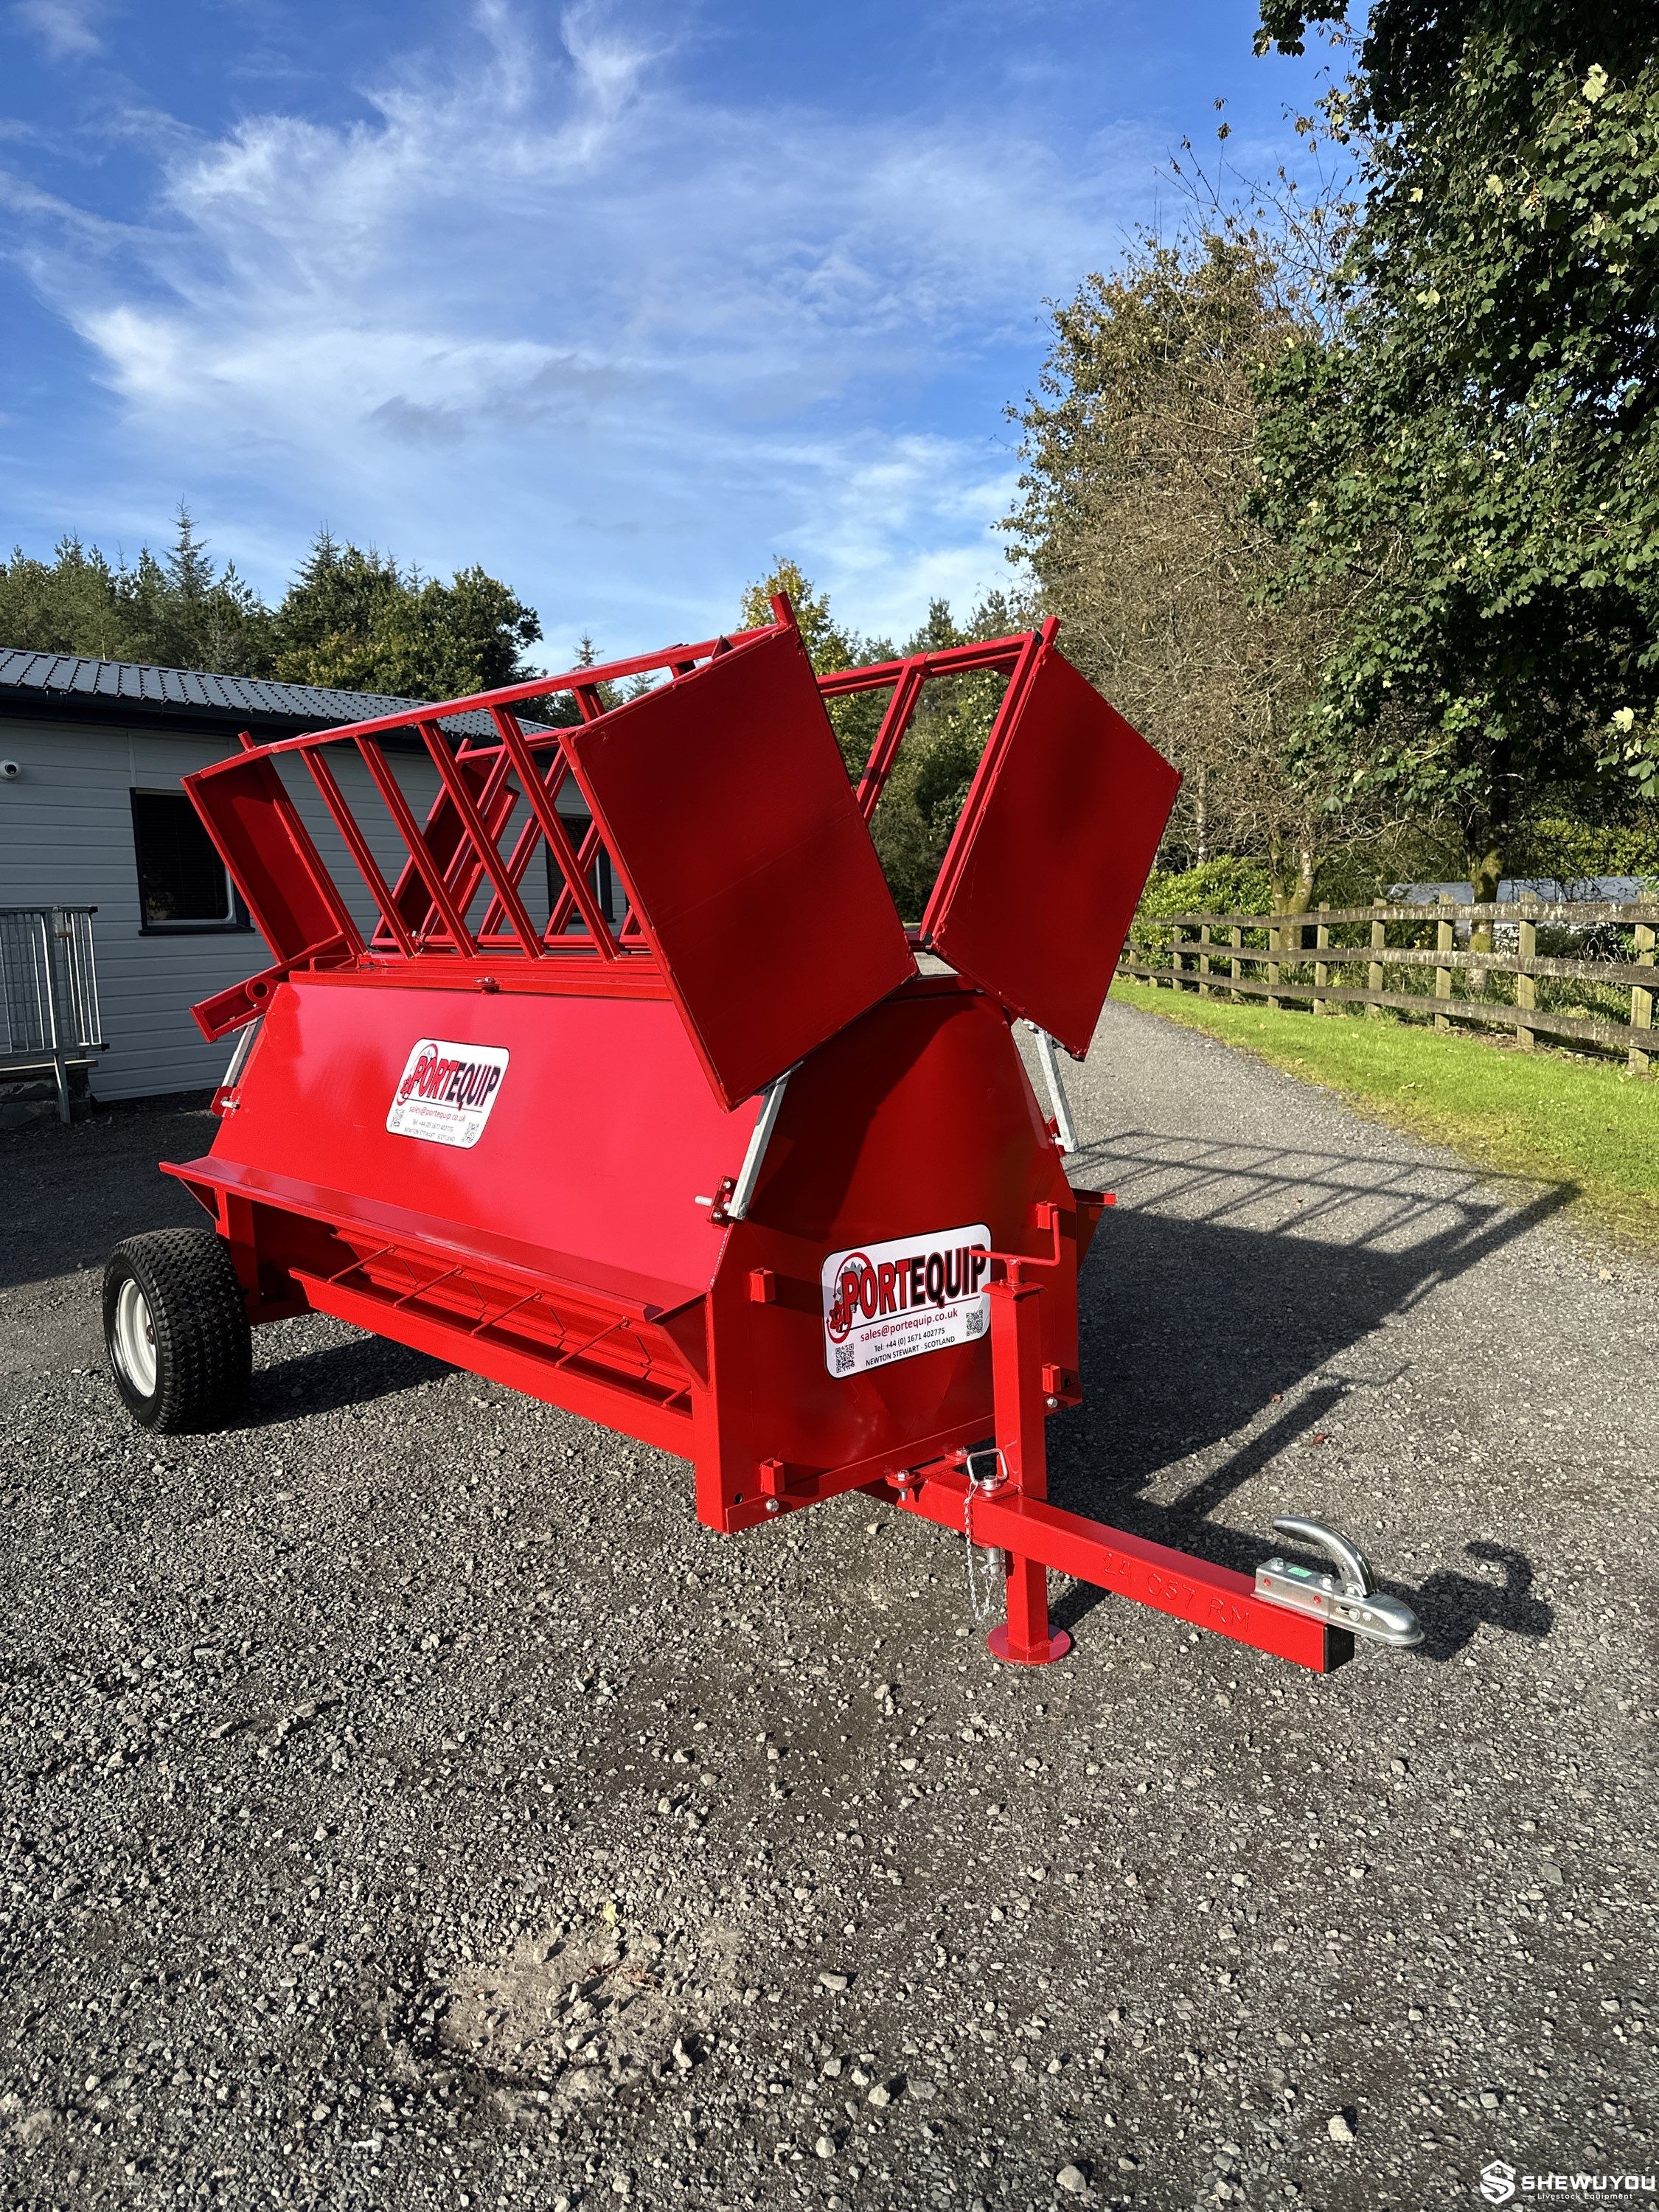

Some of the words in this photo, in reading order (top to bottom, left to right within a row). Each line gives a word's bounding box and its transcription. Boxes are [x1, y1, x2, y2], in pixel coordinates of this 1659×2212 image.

[408, 1055, 502, 1111] PORTEQUIP
[408, 1106, 466, 1121] sales@portequip.co.uk
[841, 1243, 987, 1324] PORTEQUIP
[860, 1308, 959, 1342] sales@portequip.co.uk
[886, 1340, 897, 1349] +44
[897, 1337, 906, 1347] (0)
[908, 1332, 922, 1343] 1671
[923, 1327, 945, 1339] 402775
[866, 1353, 891, 1366] NEWTON
[892, 1345, 919, 1359] STEWART
[924, 1336, 956, 1349] SCOTLAND
[1208, 1594, 1250, 1632] RM
